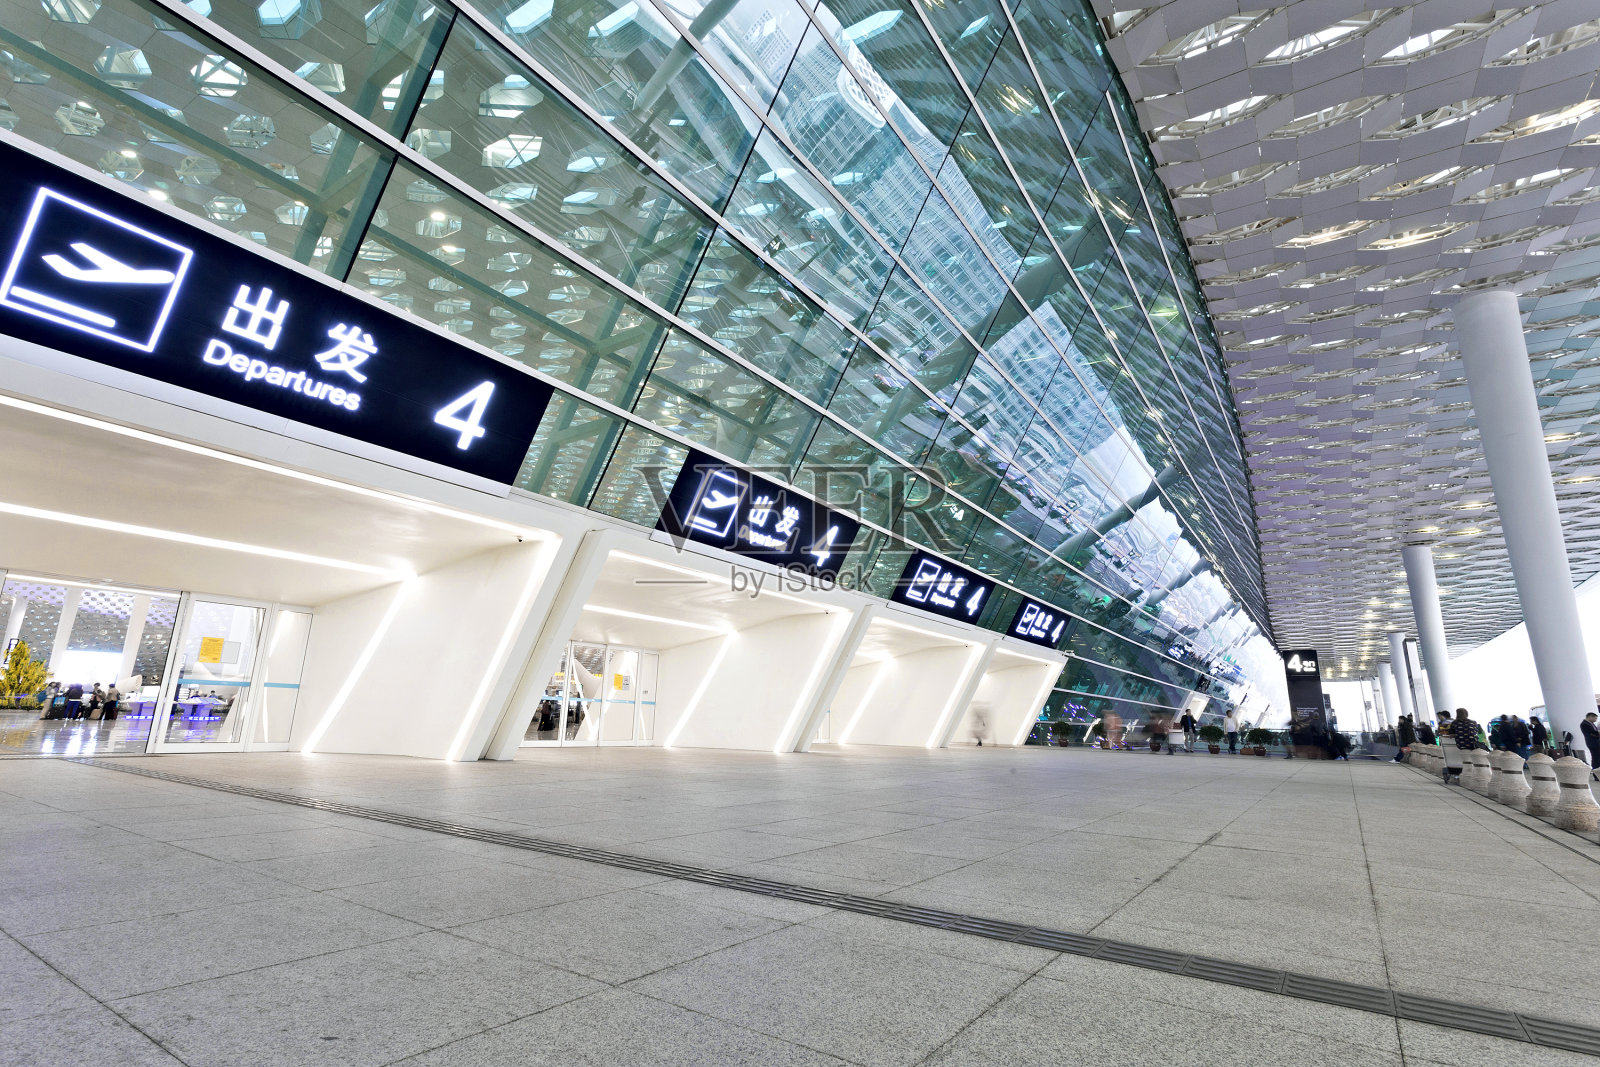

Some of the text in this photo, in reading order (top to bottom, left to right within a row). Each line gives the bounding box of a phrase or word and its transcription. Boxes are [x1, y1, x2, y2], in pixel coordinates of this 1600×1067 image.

[221, 284, 378, 383] 出发
[203, 338, 362, 411] Departures
[434, 380, 495, 450] 4
[747, 495, 800, 537] 出发
[811, 525, 839, 567] 4
[966, 586, 985, 616] 4
[1052, 620, 1065, 643] 4
[1287, 654, 1303, 672] 4
